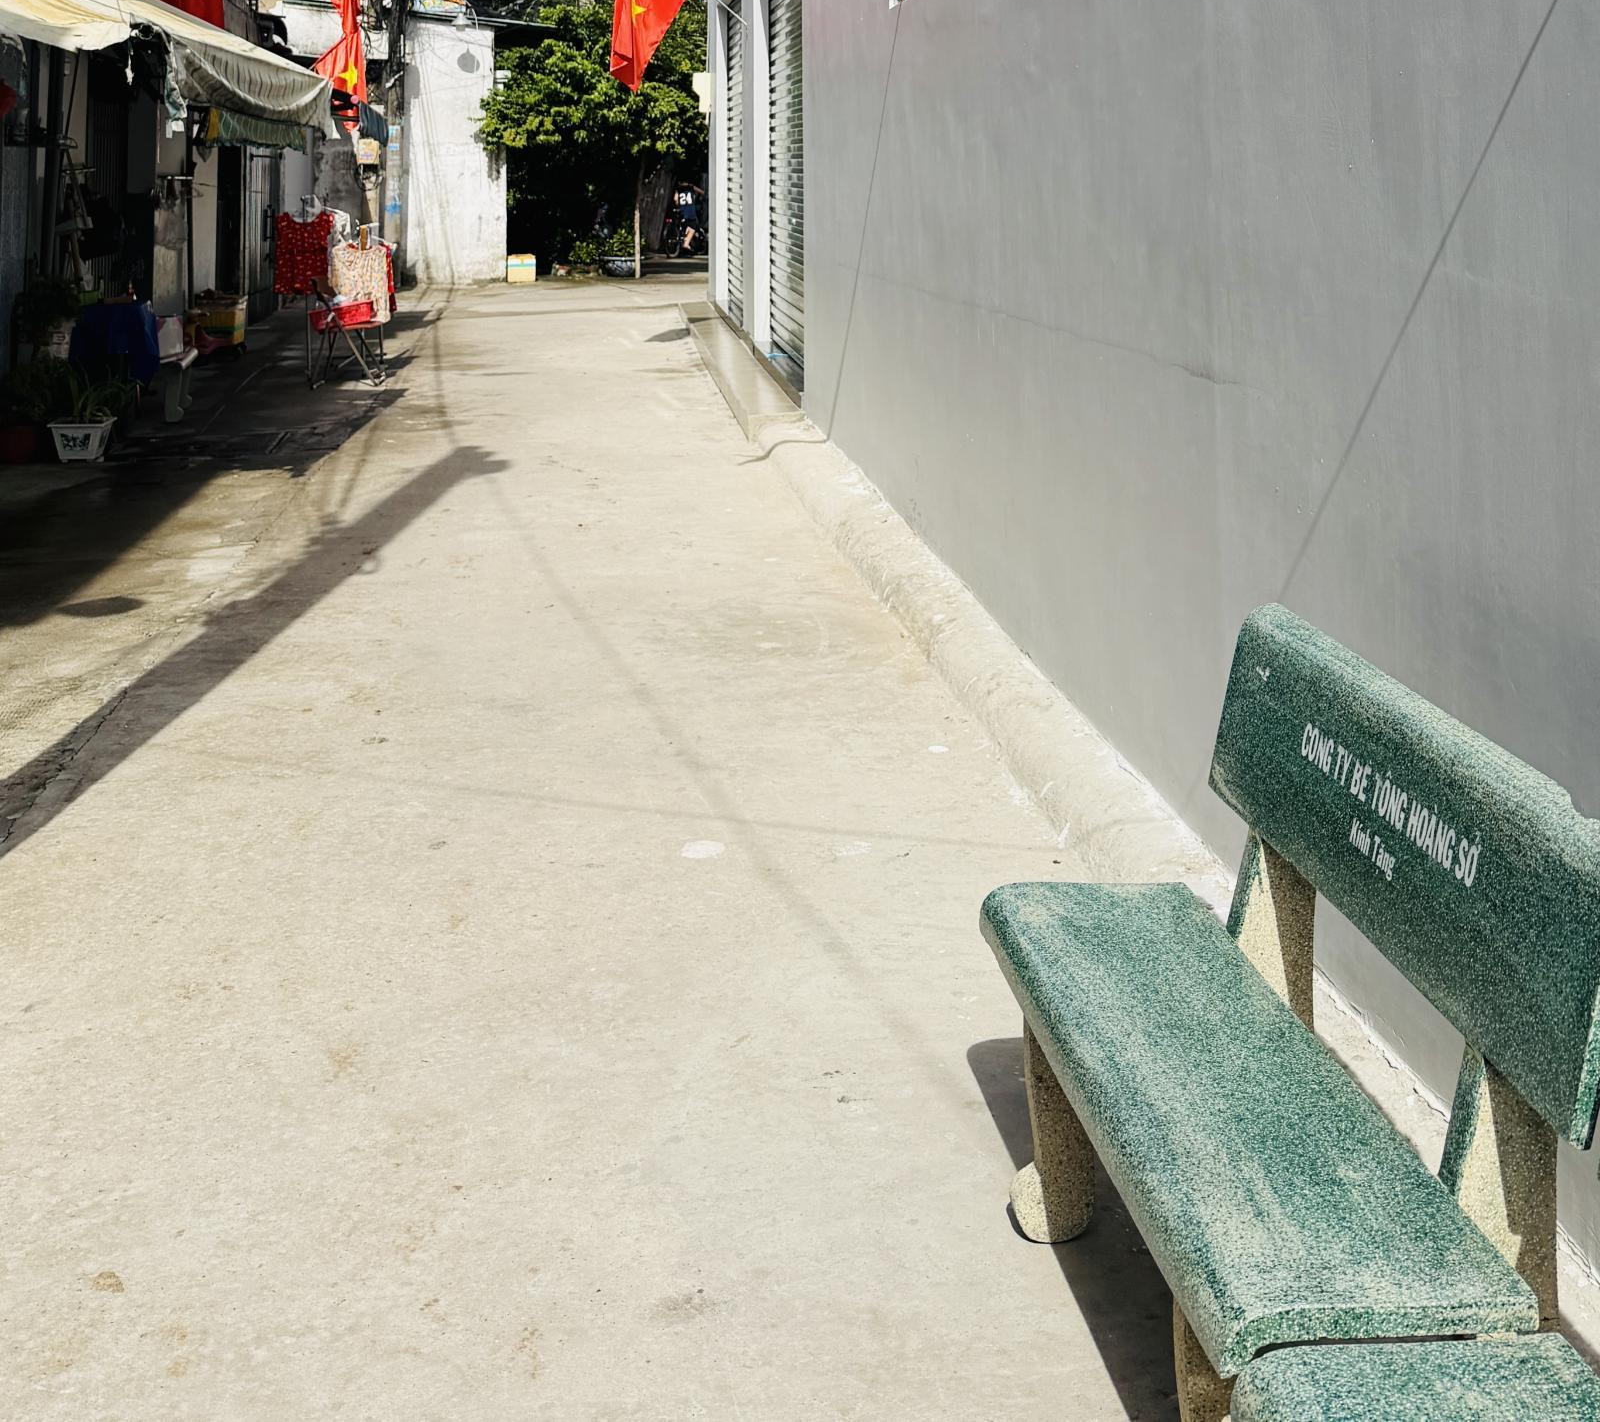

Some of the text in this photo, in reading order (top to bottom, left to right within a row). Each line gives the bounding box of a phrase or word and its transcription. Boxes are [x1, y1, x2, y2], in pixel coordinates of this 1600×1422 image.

[1333, 744, 1354, 787] TY
[1371, 770, 1408, 832] TÔNG
[1406, 800, 1456, 871] HOÀNG
